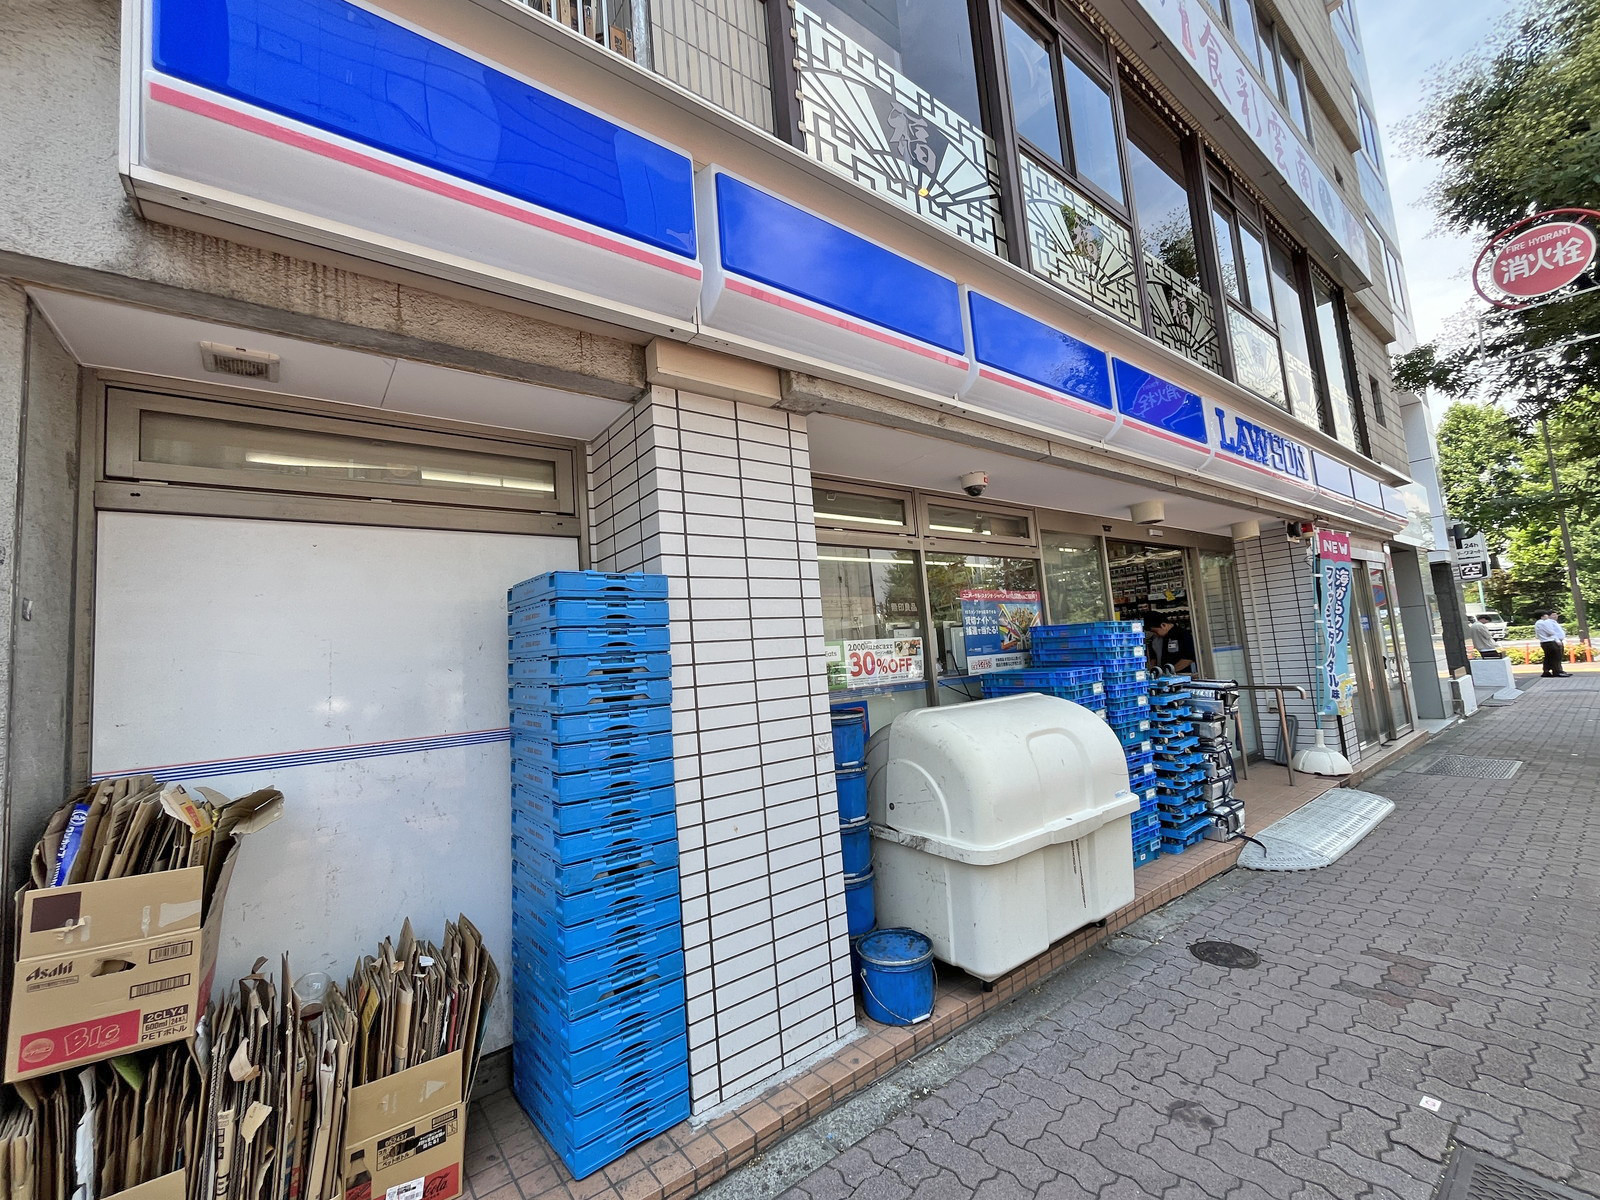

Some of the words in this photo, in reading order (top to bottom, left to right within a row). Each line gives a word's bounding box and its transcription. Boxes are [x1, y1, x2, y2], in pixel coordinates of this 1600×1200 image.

[1506, 241, 1526, 254] FIRE
[1528, 226, 1572, 247] HYDRANT
[1500, 236, 1585, 284] 消火栓
[1214, 406, 1309, 481] LAWSON
[1323, 539, 1348, 555] NEW
[26, 960, 73, 982] Asahi
[146, 1007, 185, 1022] 2CLY4
[64, 1024, 120, 1057] BIG
[141, 1025, 188, 1042] PETボトル
